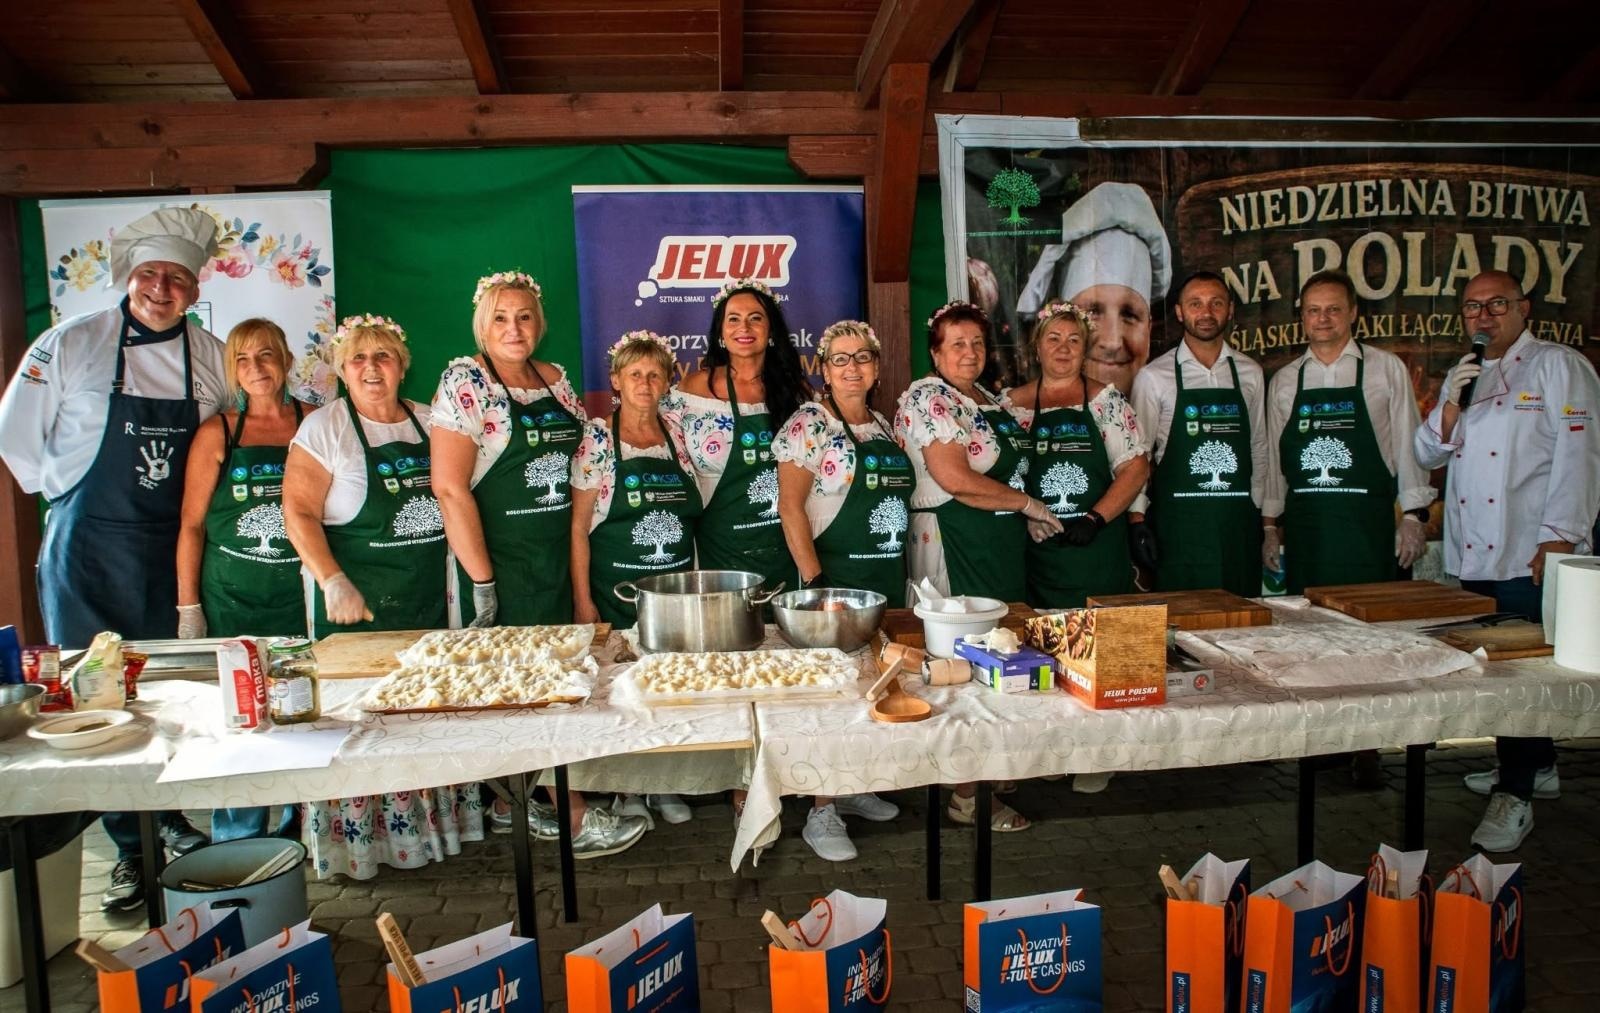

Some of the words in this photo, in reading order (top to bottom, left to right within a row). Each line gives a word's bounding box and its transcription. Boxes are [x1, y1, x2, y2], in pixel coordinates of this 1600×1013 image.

[1219, 179, 1456, 235] NIEDZIELNA
[1467, 181, 1590, 226] BITWA
[657, 244, 788, 279] JELUX
[1221, 260, 1281, 304] NA
[684, 295, 705, 303] SMAKU
[1400, 314, 1464, 343] ŁĄCZĄ
[125, 422, 136, 436] R
[1104, 690, 1125, 698] JELUX
[1128, 686, 1159, 697] POLSKA
[1004, 936, 1072, 956] INNOVATIVE
[1010, 949, 1046, 969] JELUX
[637, 951, 684, 1004] JELUX
